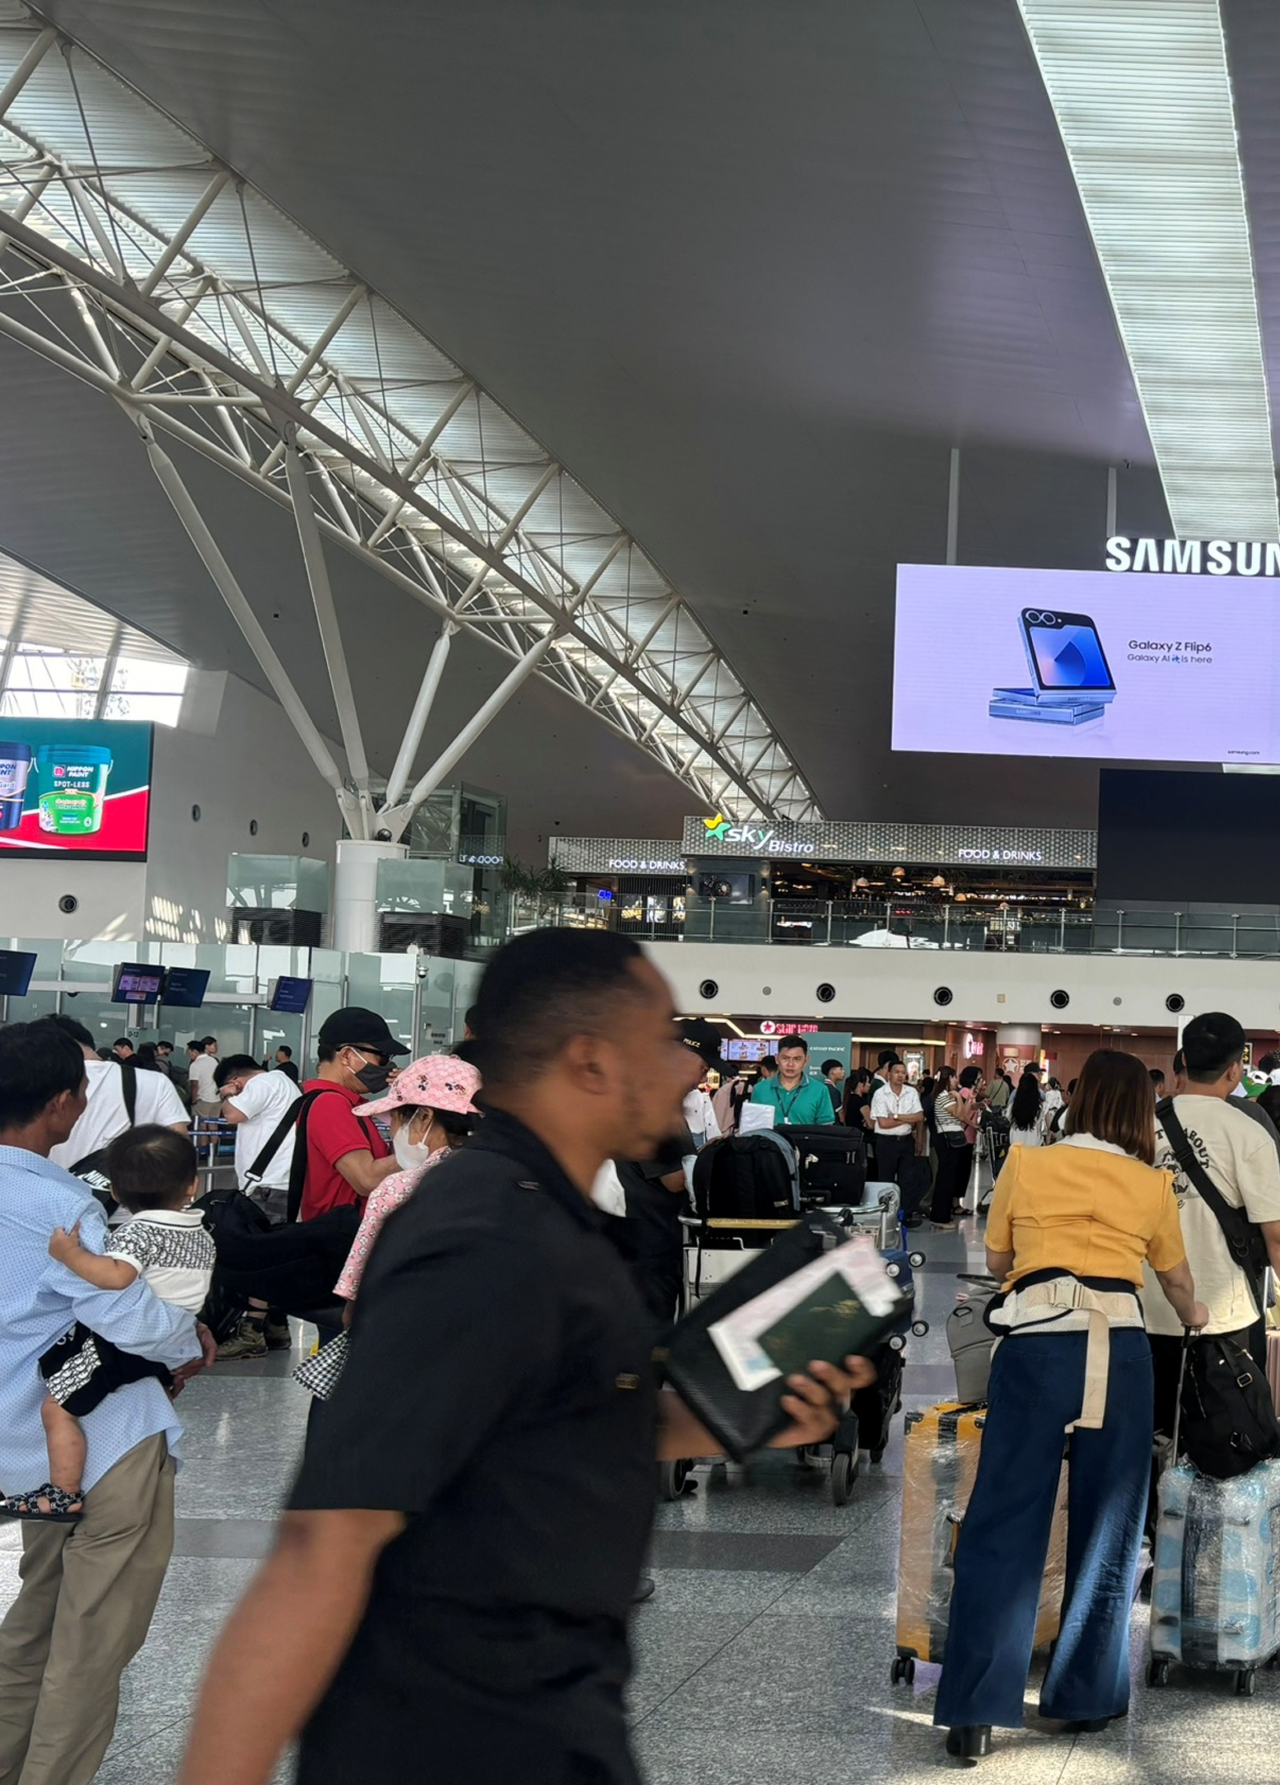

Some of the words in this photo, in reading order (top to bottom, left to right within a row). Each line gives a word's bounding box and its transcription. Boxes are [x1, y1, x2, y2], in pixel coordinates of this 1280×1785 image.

[1128, 640, 1173, 653] Galaxy
[1175, 641, 1182, 651] Z
[1184, 642, 1212, 654] Flip6
[1127, 653, 1160, 663] Galaxy
[1190, 656, 1213, 664] here
[725, 825, 774, 850] sky
[769, 840, 814, 853] Bistro
[958, 849, 990, 860] FOOD
[993, 851, 1000, 860] &
[1003, 850, 1041, 861] DRINKS
[609, 859, 639, 868] FOOD
[640, 861, 647, 869] &
[649, 861, 685, 870] DRINKS
[683, 1038, 701, 1048] POLICE
[84, 1169, 111, 1188] NIKE
